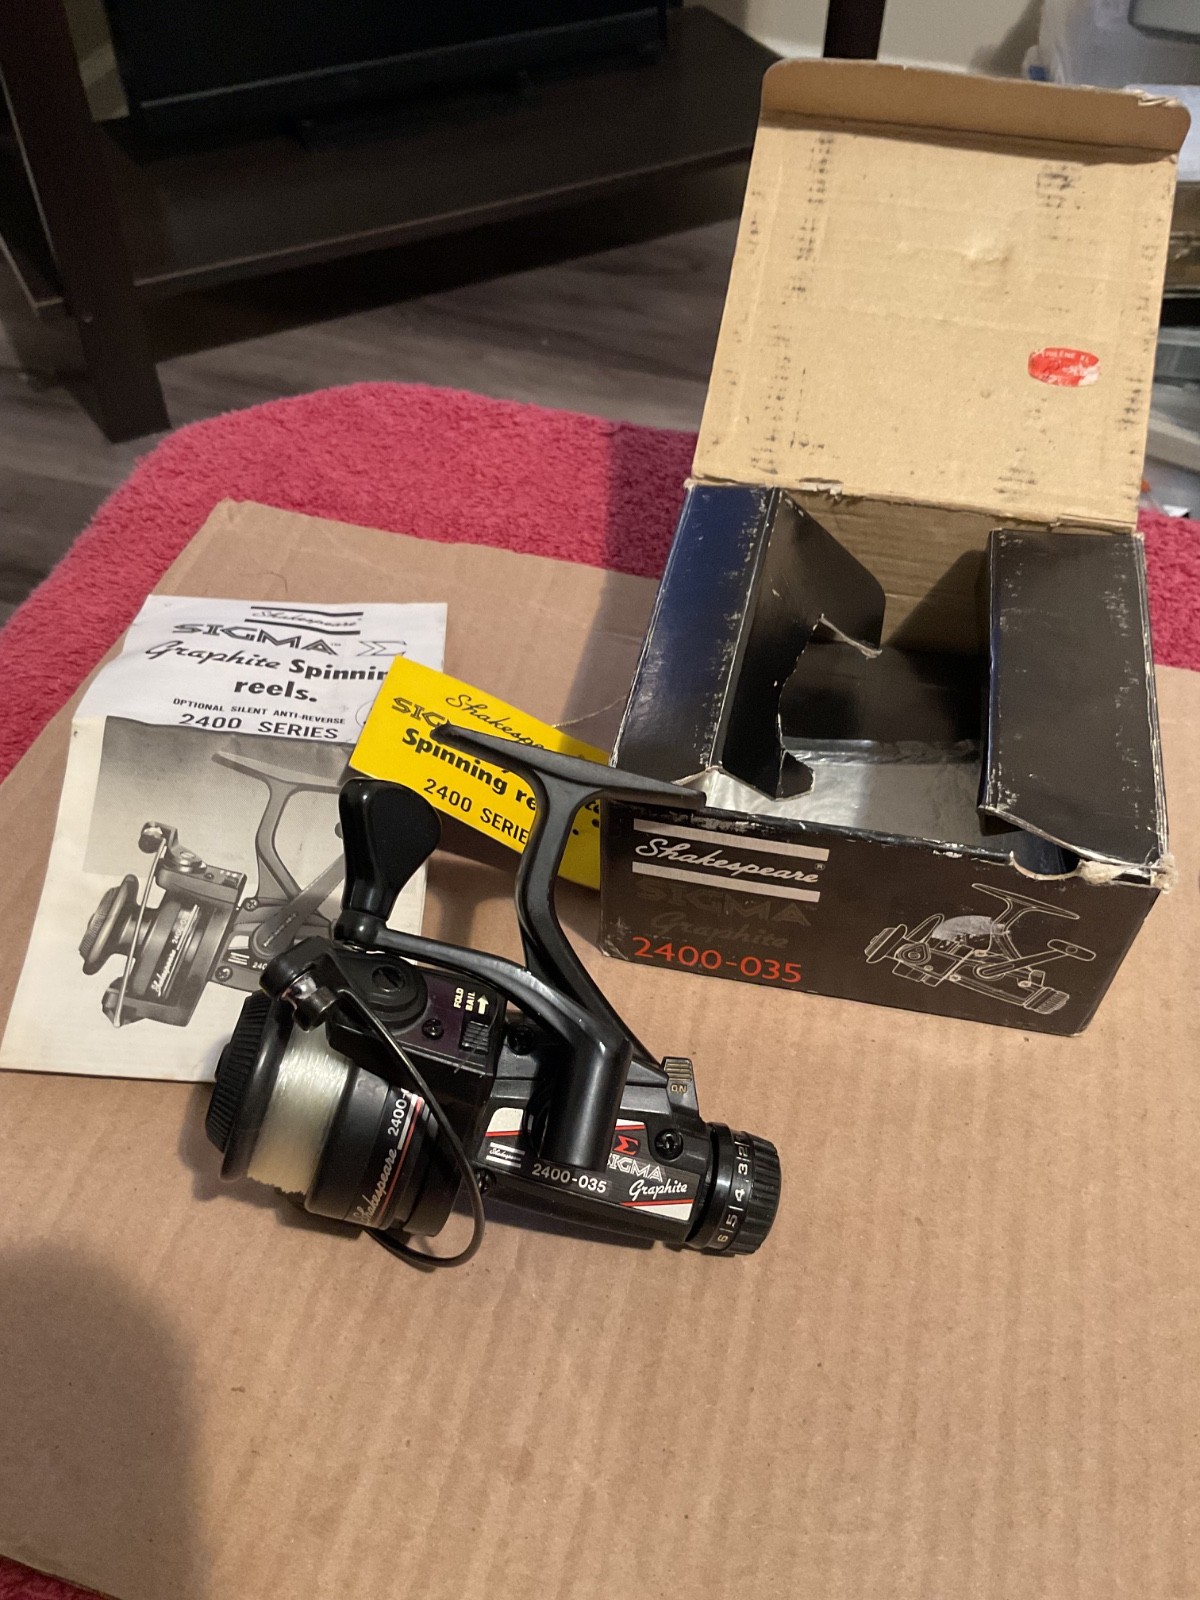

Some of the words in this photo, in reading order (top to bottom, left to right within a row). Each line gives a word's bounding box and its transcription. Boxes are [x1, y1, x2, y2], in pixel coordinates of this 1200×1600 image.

[172, 623, 339, 656] SIGMA
[145, 640, 281, 670] Graphite
[288, 658, 389, 681] Spinnin
[233, 680, 318, 702] reels.
[172, 697, 225, 712] OPTIONAL
[230, 705, 268, 716] SILENT
[273, 709, 346, 725] ANTI-REVERSE
[177, 713, 242, 730] 2400
[257, 720, 339, 740] SERIES
[401, 727, 509, 796] Spinning
[423, 777, 473, 814] 2400
[479, 807, 530, 845] SERIE
[635, 838, 820, 884] Shakespeare
[631, 935, 803, 984] 2400-035
[453, 987, 464, 1009] FOLD
[465, 991, 476, 1012] BAIL
[671, 1084, 688, 1093] ON
[531, 1163, 608, 1194] 2400-035
[737, 1162, 749, 1176] 3
[628, 1178, 689, 1202] Graphite
[733, 1187, 747, 1203] 4
[725, 1213, 739, 1228] 5
[716, 1233, 729, 1243] 6
